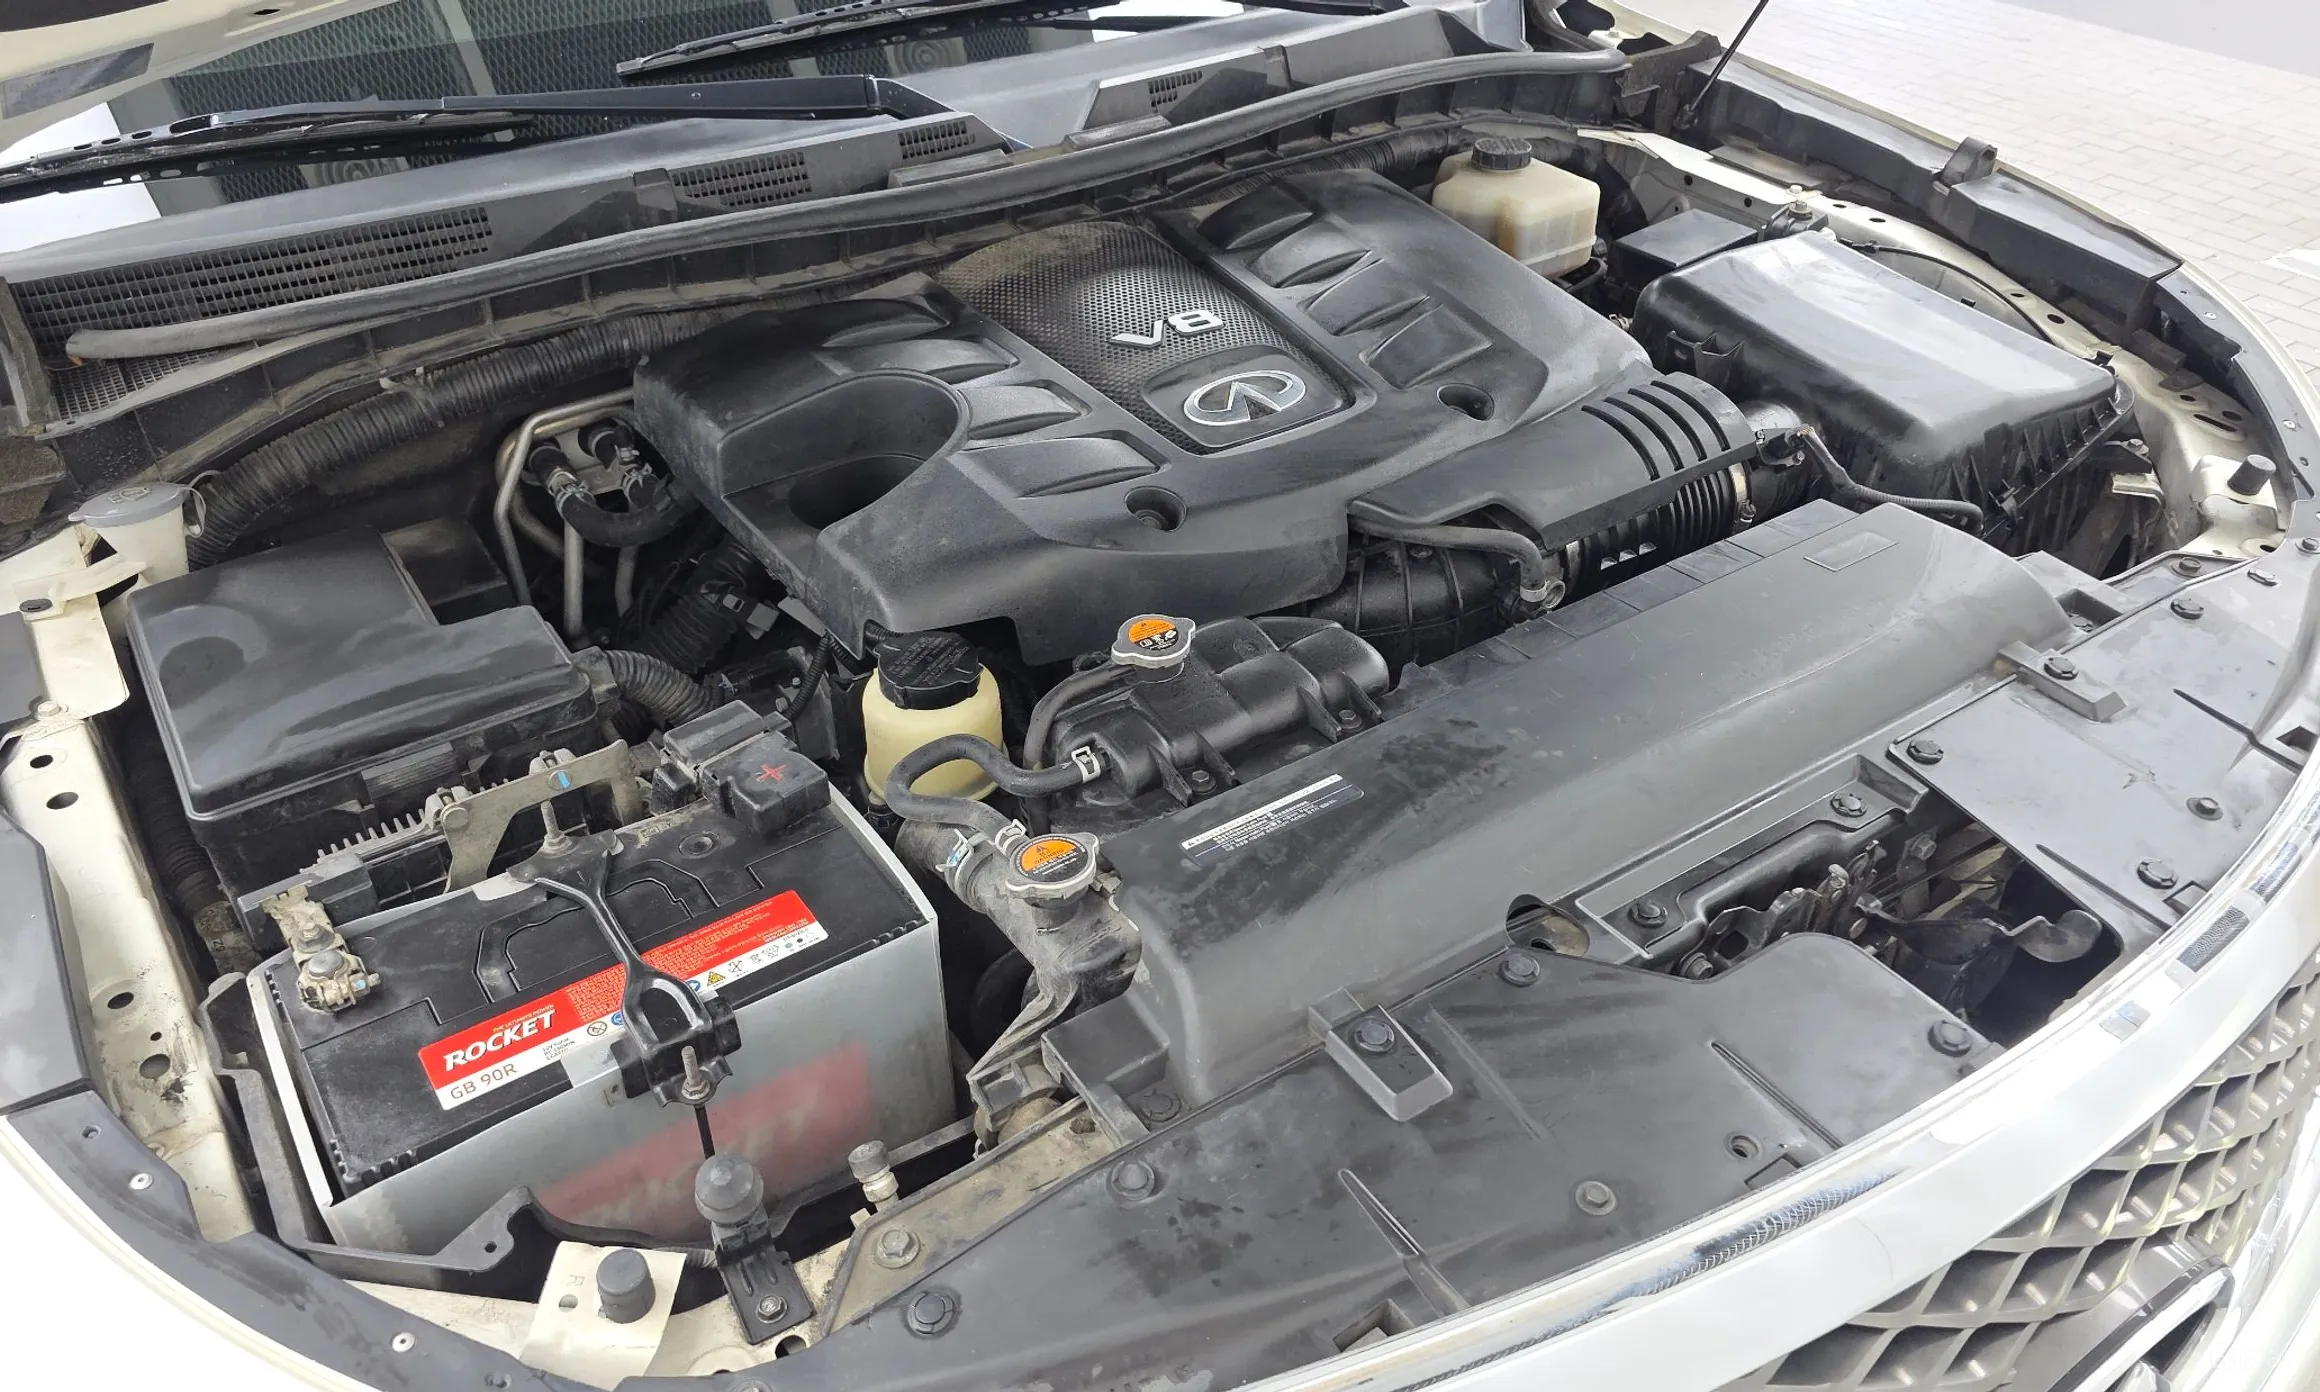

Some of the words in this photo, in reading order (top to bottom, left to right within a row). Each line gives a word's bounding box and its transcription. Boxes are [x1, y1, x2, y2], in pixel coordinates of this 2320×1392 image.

[1108, 309, 1225, 348] V8
[504, 1012, 532, 1029] ULTIMATE
[532, 1003, 555, 1017] POWER
[443, 1009, 557, 1072] ROCKET
[450, 1080, 477, 1099] GB
[480, 1063, 518, 1086] 90R
